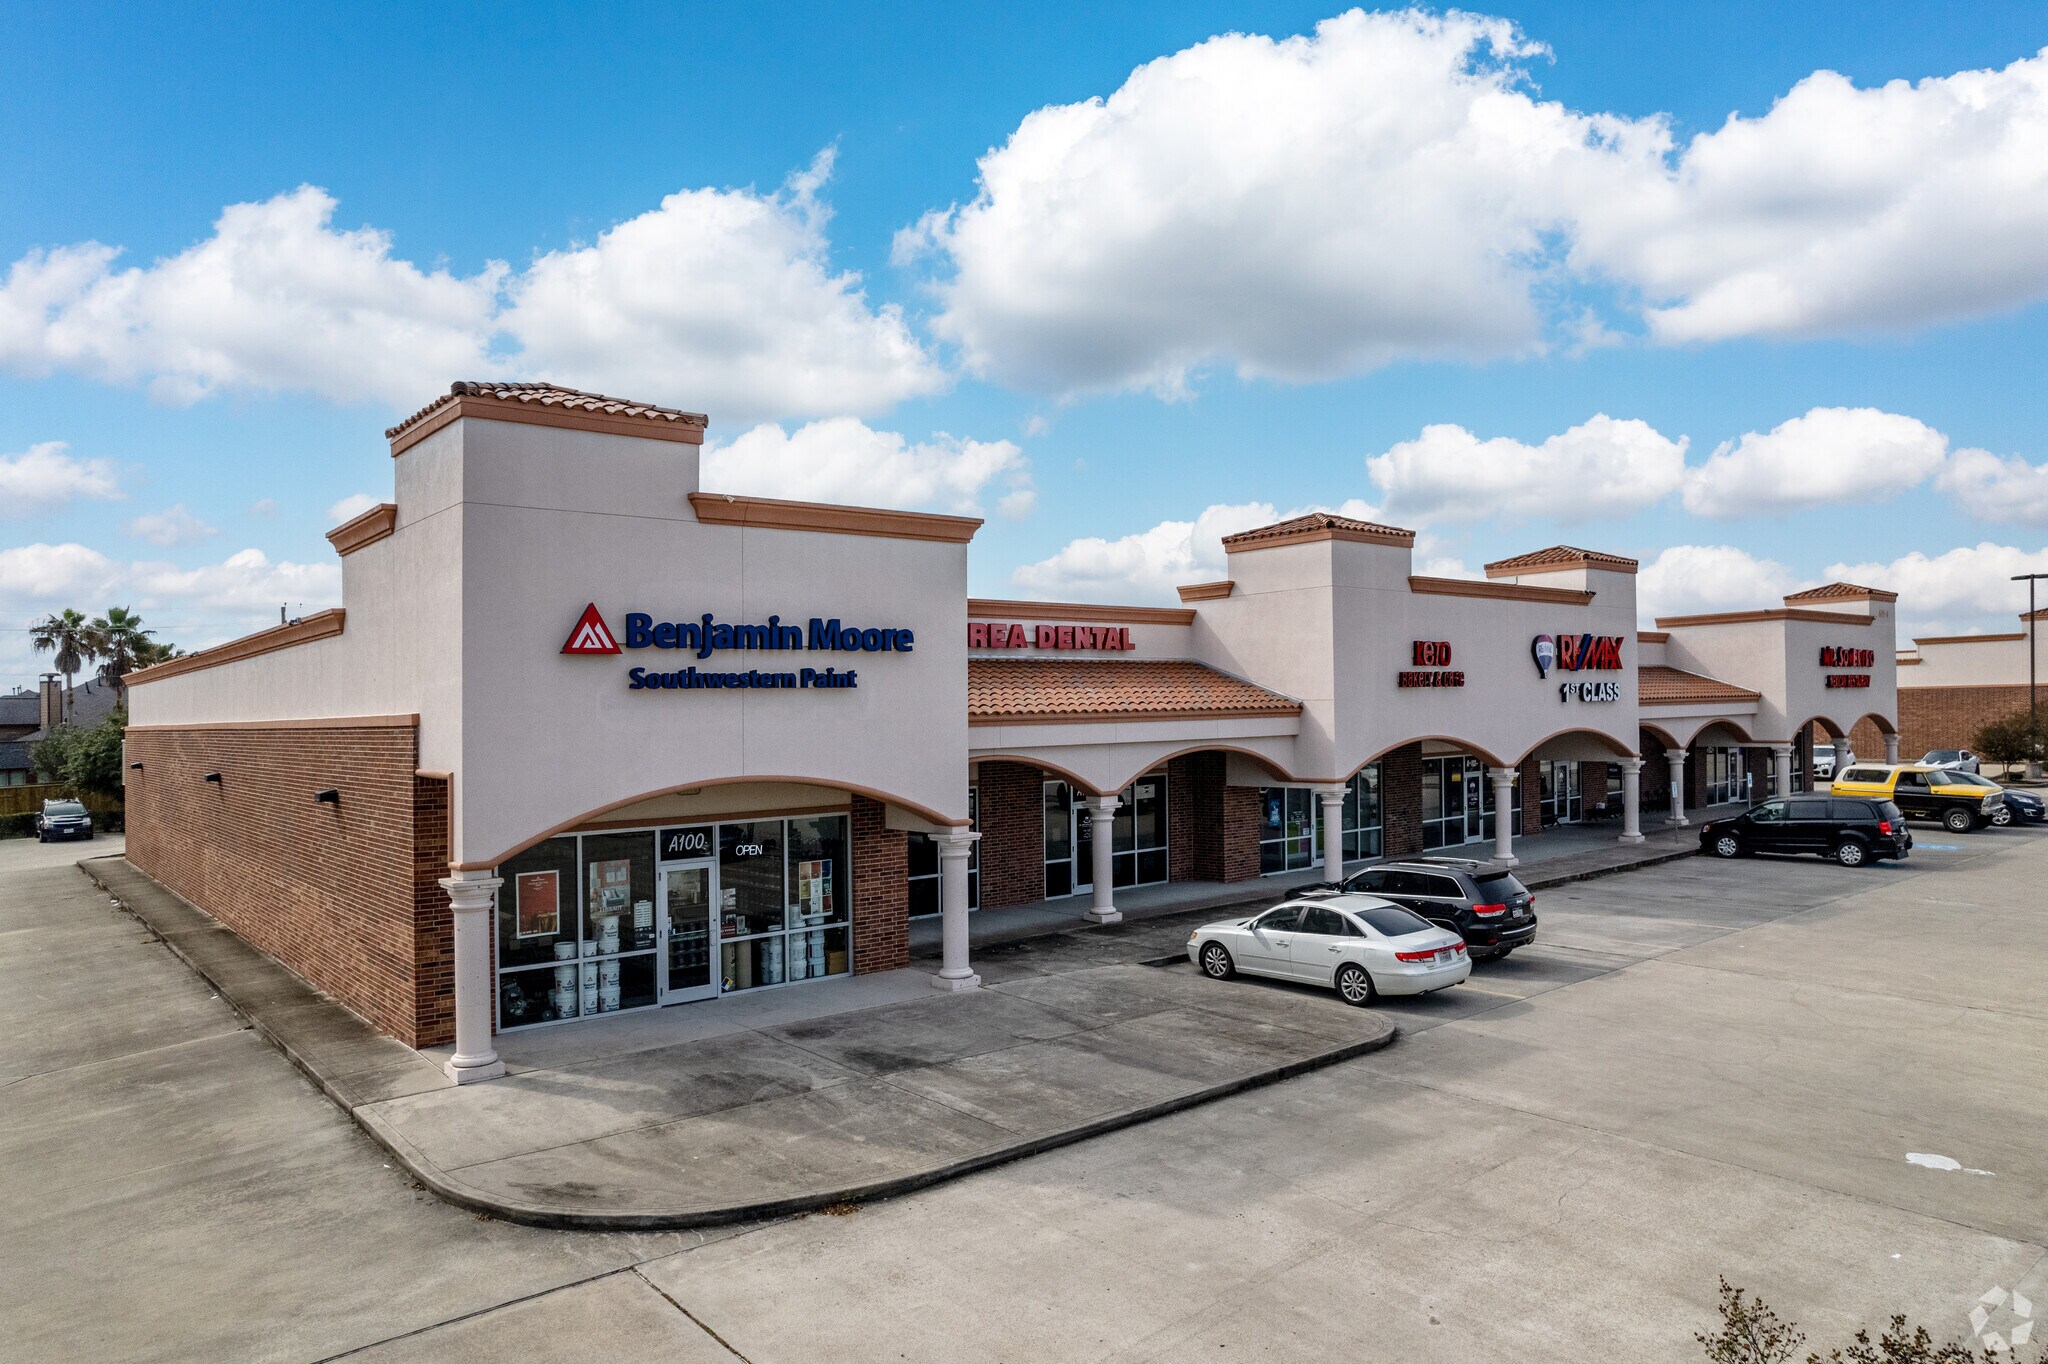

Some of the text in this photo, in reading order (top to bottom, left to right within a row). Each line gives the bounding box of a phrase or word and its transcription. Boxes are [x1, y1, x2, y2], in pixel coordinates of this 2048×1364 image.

[625, 612, 914, 659] Benjamin Moore
[1035, 624, 1136, 651] DENTAL
[1556, 634, 1624, 671] RE/MAX
[628, 666, 858, 690] Southwestern Paint
[1434, 671, 1441, 687] &
[1580, 682, 1620, 702] CLASS
[668, 832, 705, 853] A100
[735, 844, 763, 856] OPEN
